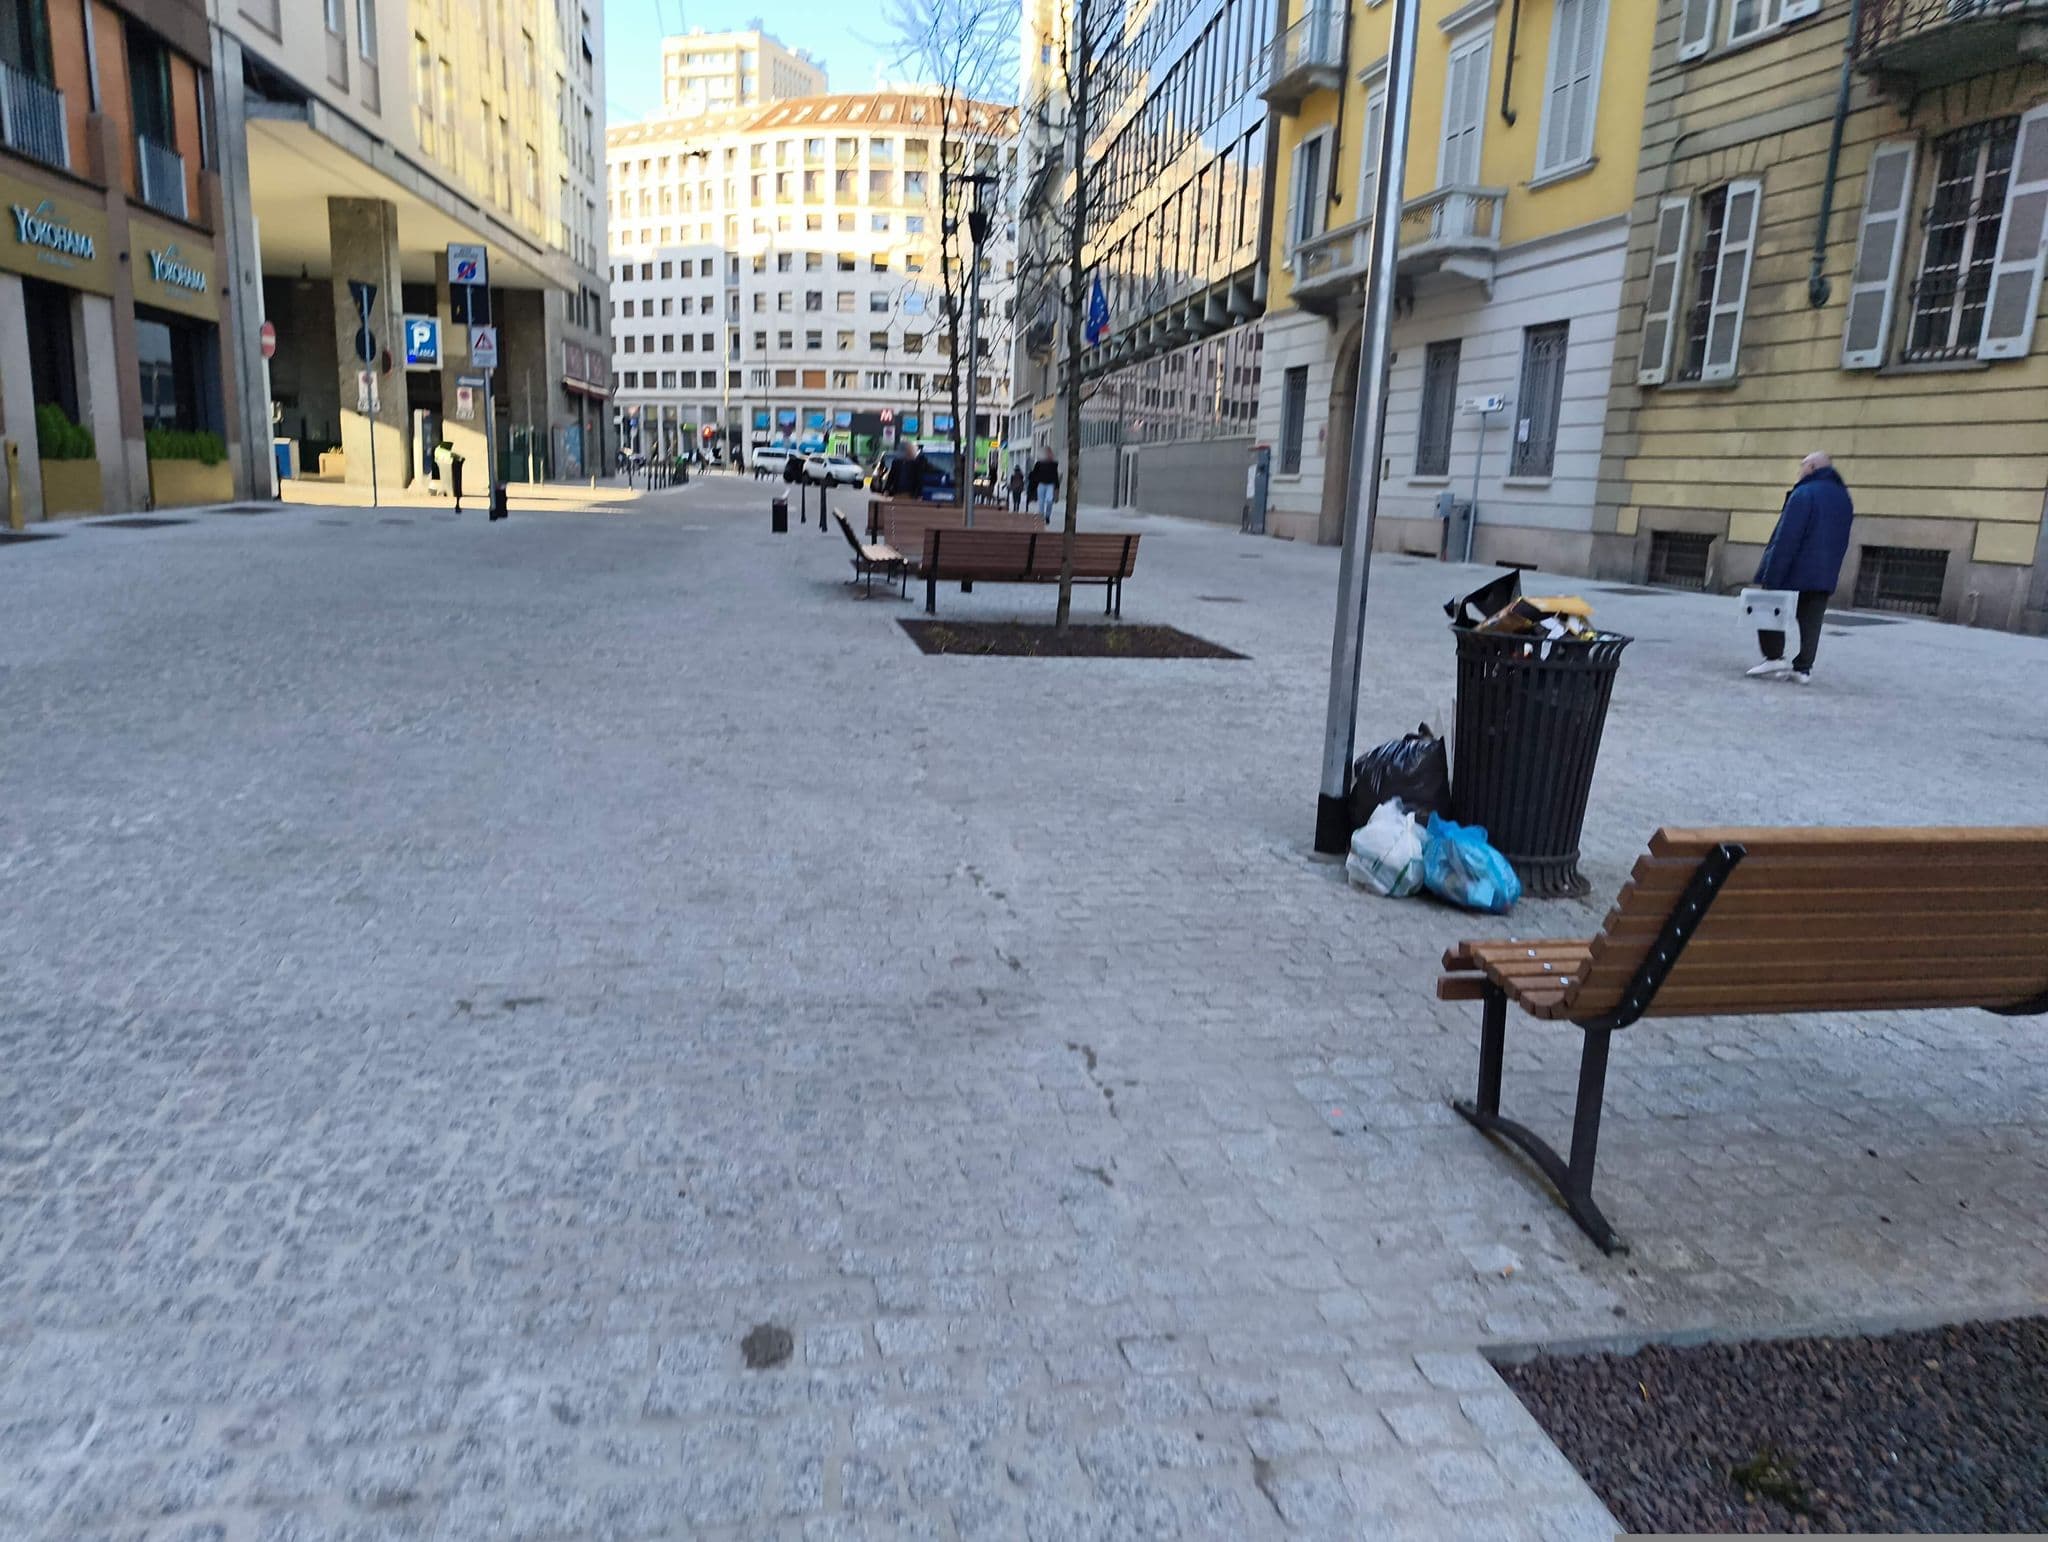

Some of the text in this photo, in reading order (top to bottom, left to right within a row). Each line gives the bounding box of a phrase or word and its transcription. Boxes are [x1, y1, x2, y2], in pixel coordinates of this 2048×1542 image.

[10, 203, 96, 260] YOKOHAMA
[148, 249, 208, 293] YOKOHAMA
[413, 325, 430, 353] P
[880, 408, 893, 421] M
